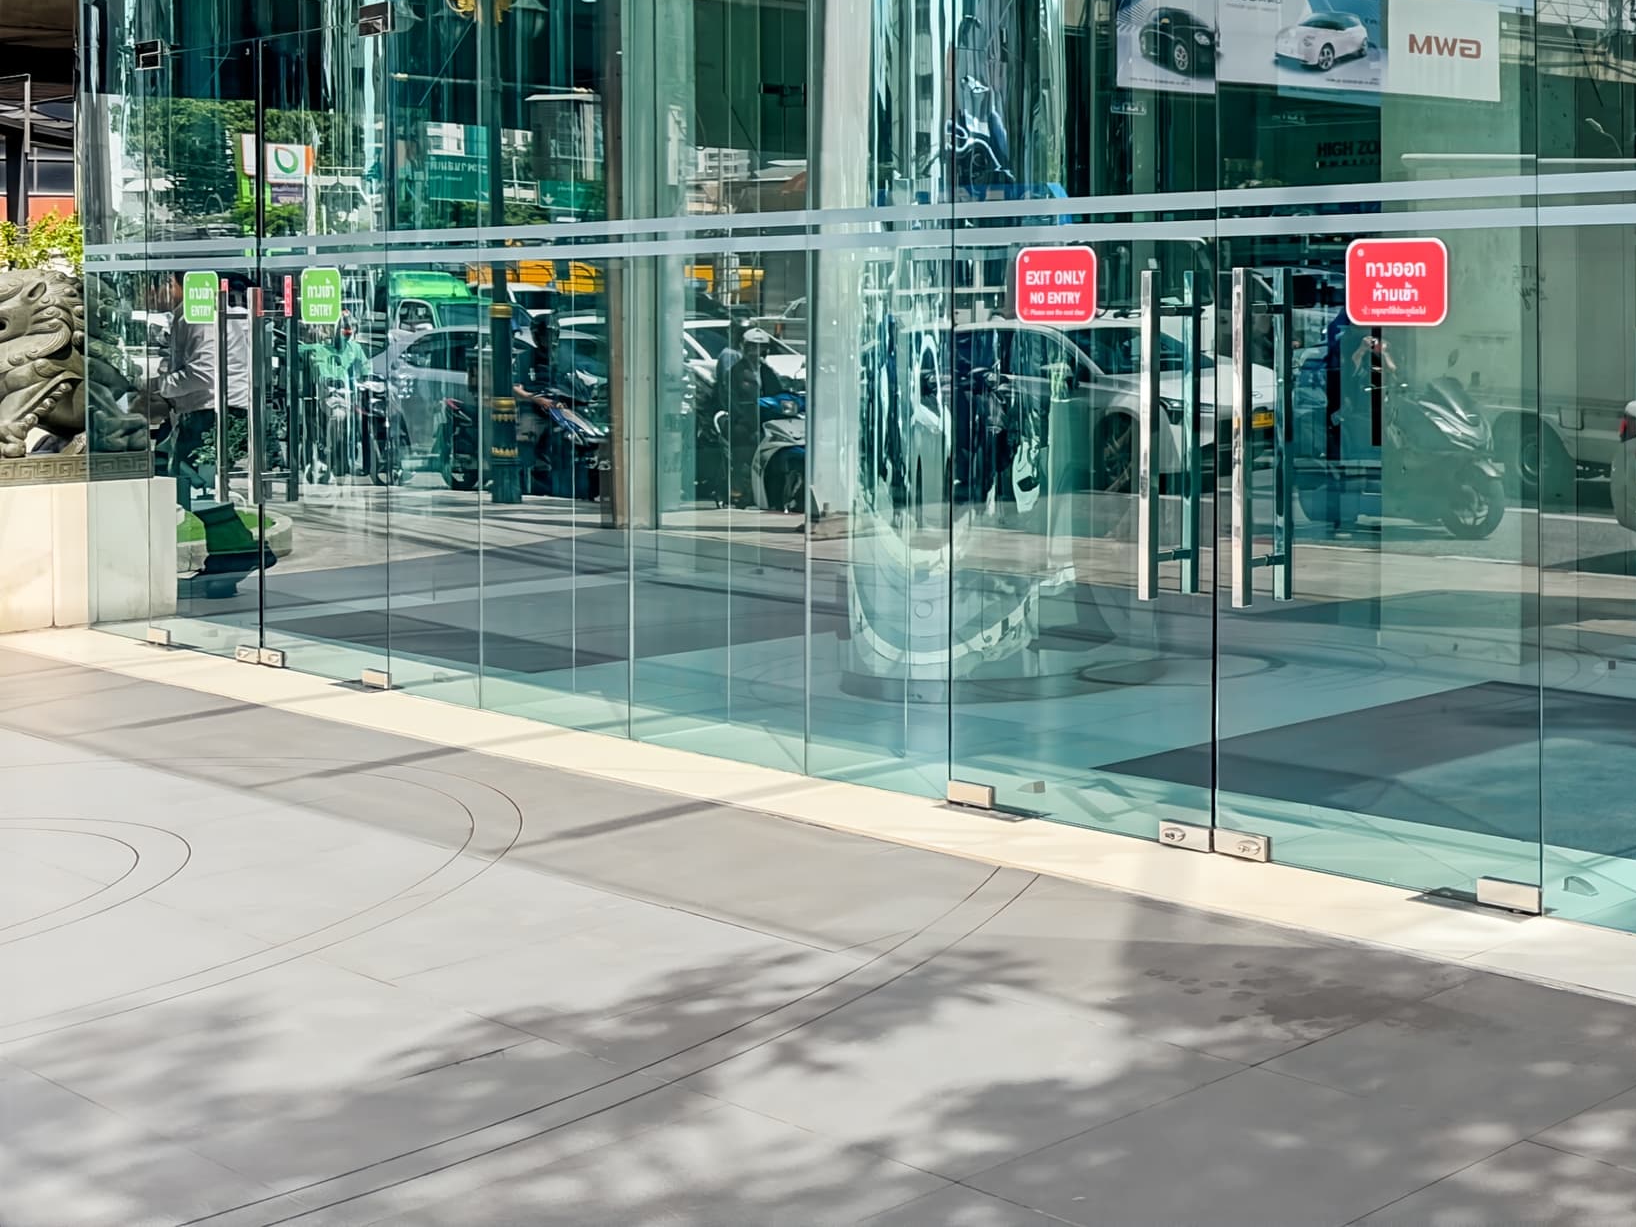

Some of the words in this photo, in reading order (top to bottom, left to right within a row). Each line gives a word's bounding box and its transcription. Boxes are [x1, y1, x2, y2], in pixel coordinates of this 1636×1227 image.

[1316, 141, 1353, 158] HIGH
[1358, 139, 1381, 156] ZO
[1025, 270, 1051, 286] EXIT
[1054, 269, 1087, 286] ONLY
[1365, 261, 1427, 278] ทางออก
[307, 277, 335, 299] ทางเข้า
[1372, 281, 1419, 303] ห้ามเข้า
[1029, 291, 1045, 305] NO
[1047, 291, 1081, 305] ENTRY
[190, 307, 213, 319] ENTRY
[309, 304, 334, 318] ENTRY
